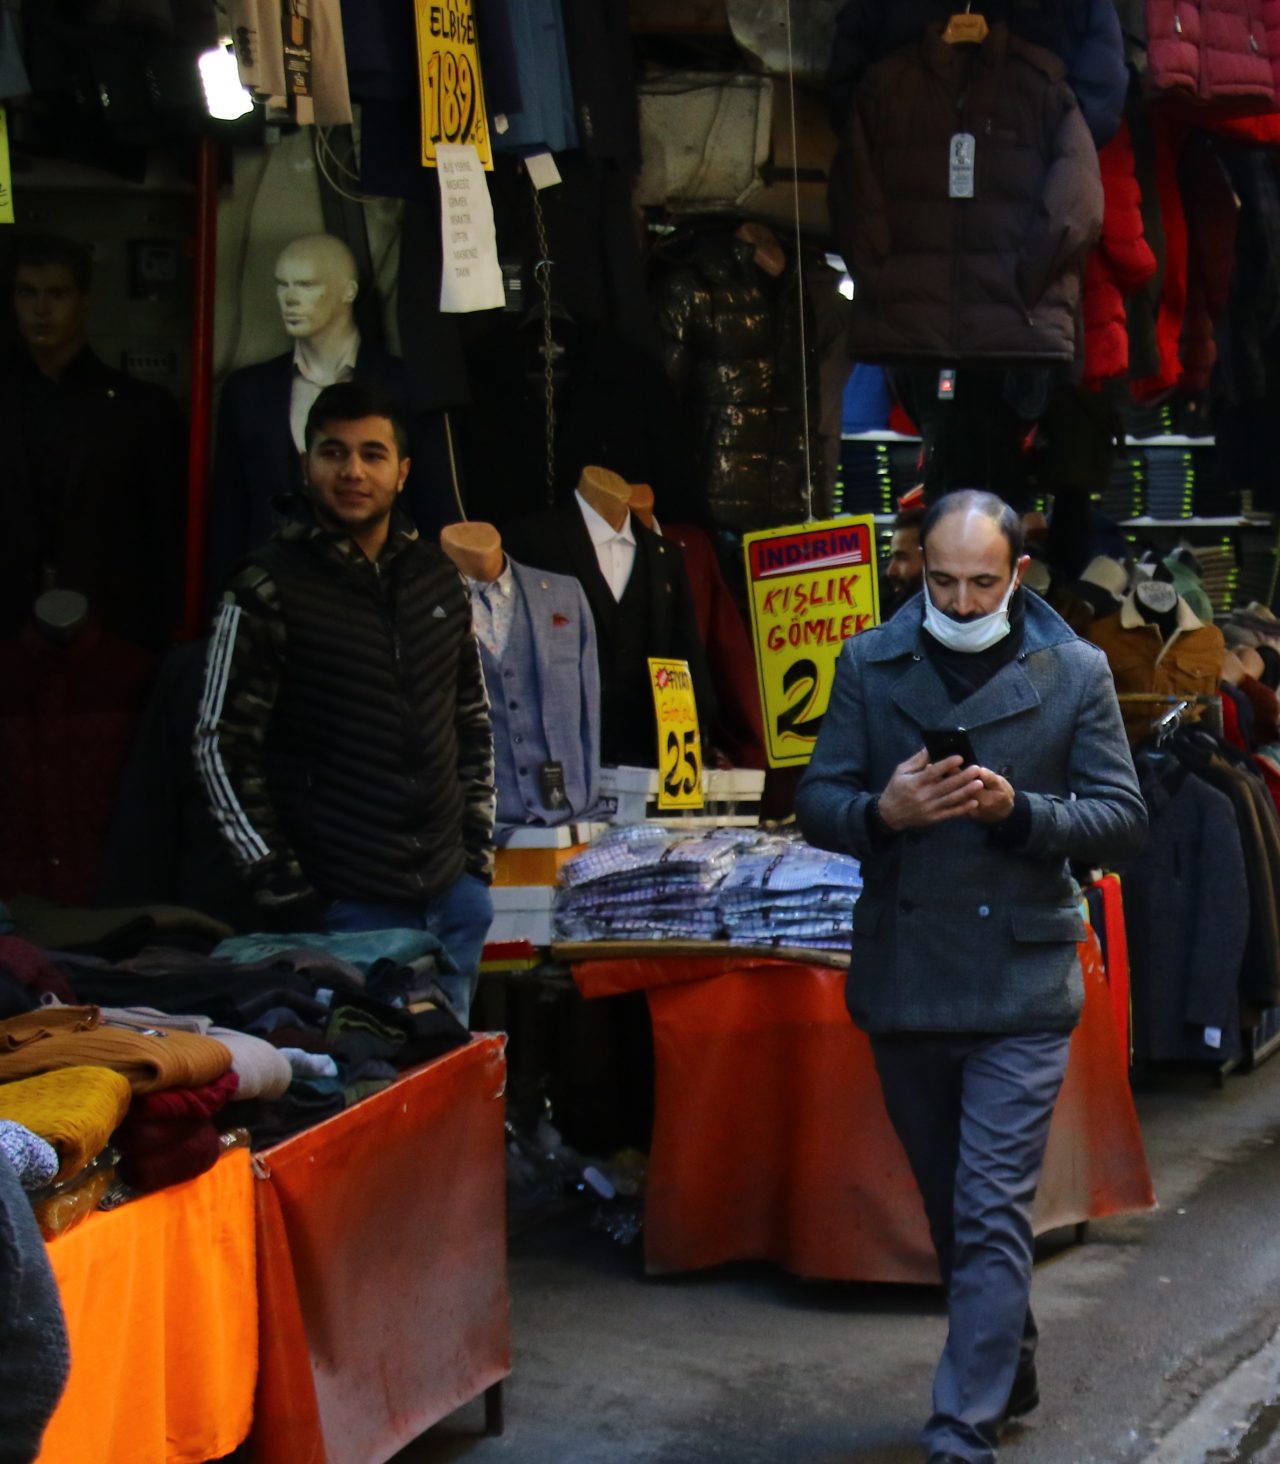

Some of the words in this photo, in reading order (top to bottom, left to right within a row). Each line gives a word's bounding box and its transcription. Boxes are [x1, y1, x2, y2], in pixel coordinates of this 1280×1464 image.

[758, 531, 860, 573] İNDİRİM
[762, 574, 861, 617] KIŞLIK
[767, 614, 871, 652] GÖMLEK
[777, 658, 832, 740] 2
